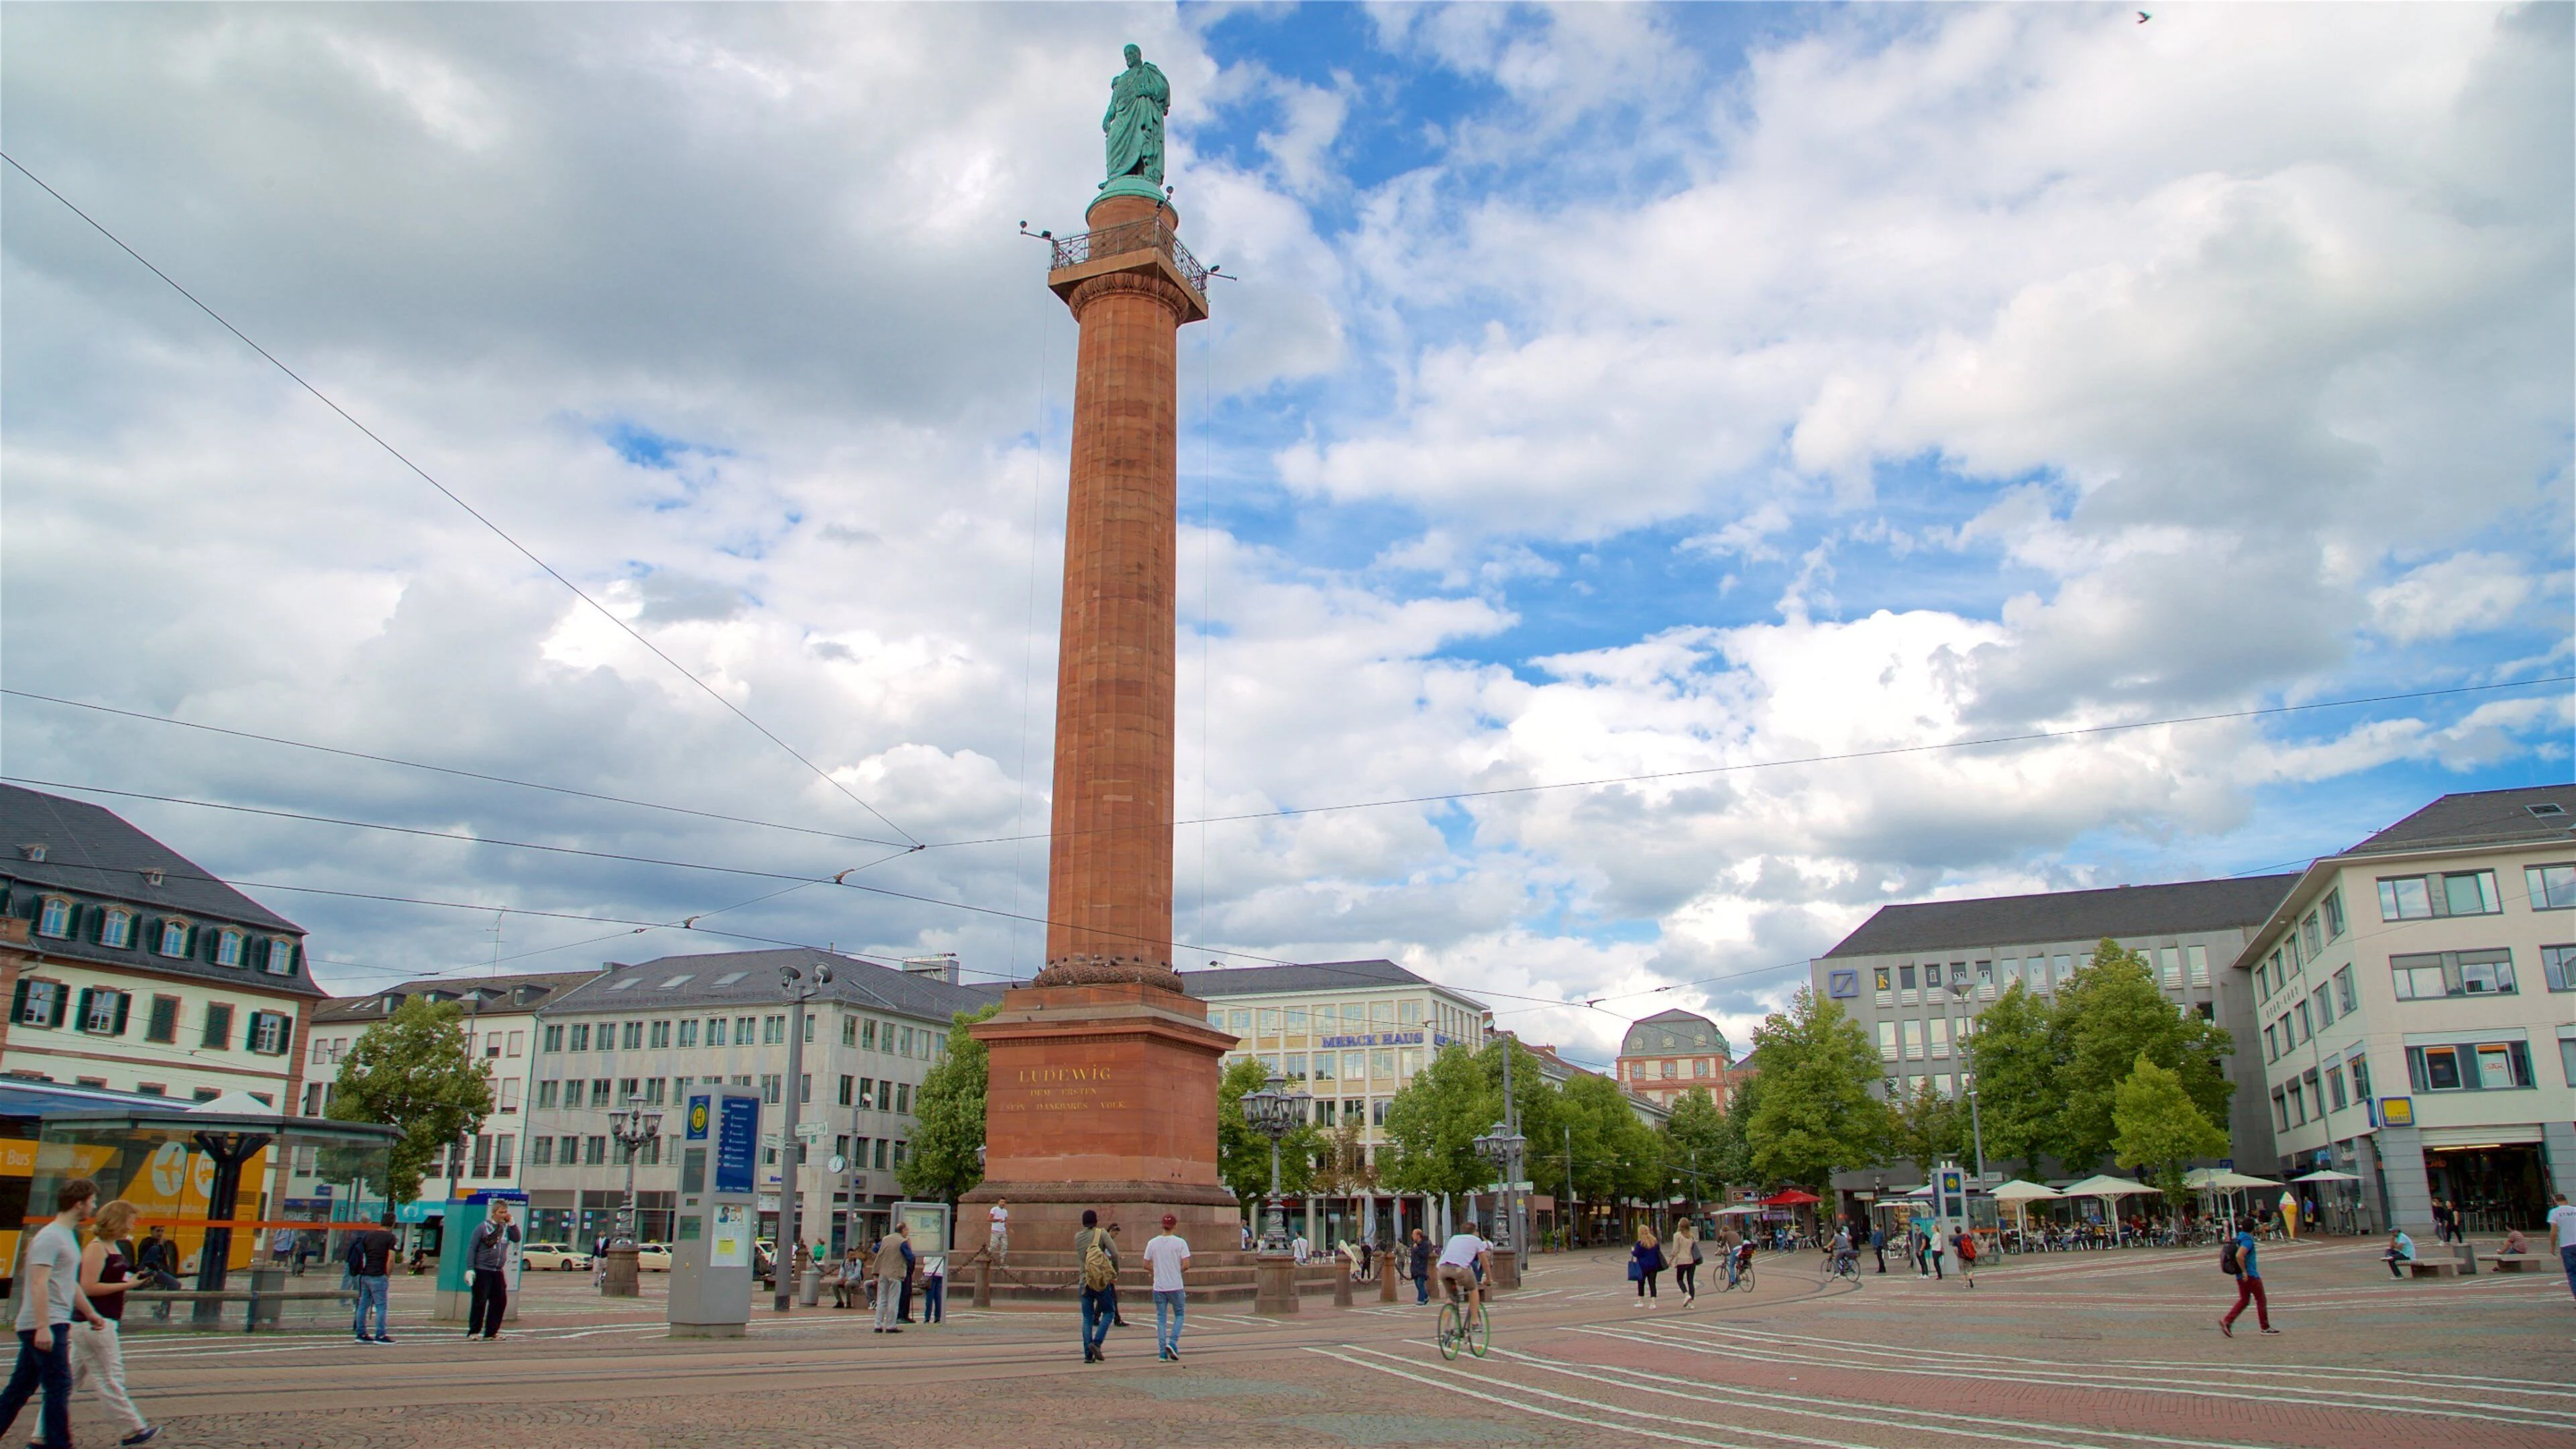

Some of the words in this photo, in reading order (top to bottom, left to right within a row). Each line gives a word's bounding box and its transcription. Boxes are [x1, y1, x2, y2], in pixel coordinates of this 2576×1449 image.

[1322, 1034, 1376, 1048] MERCK
[1381, 1032, 1423, 1045] HAUS
[7, 1148, 31, 1166] Bus
